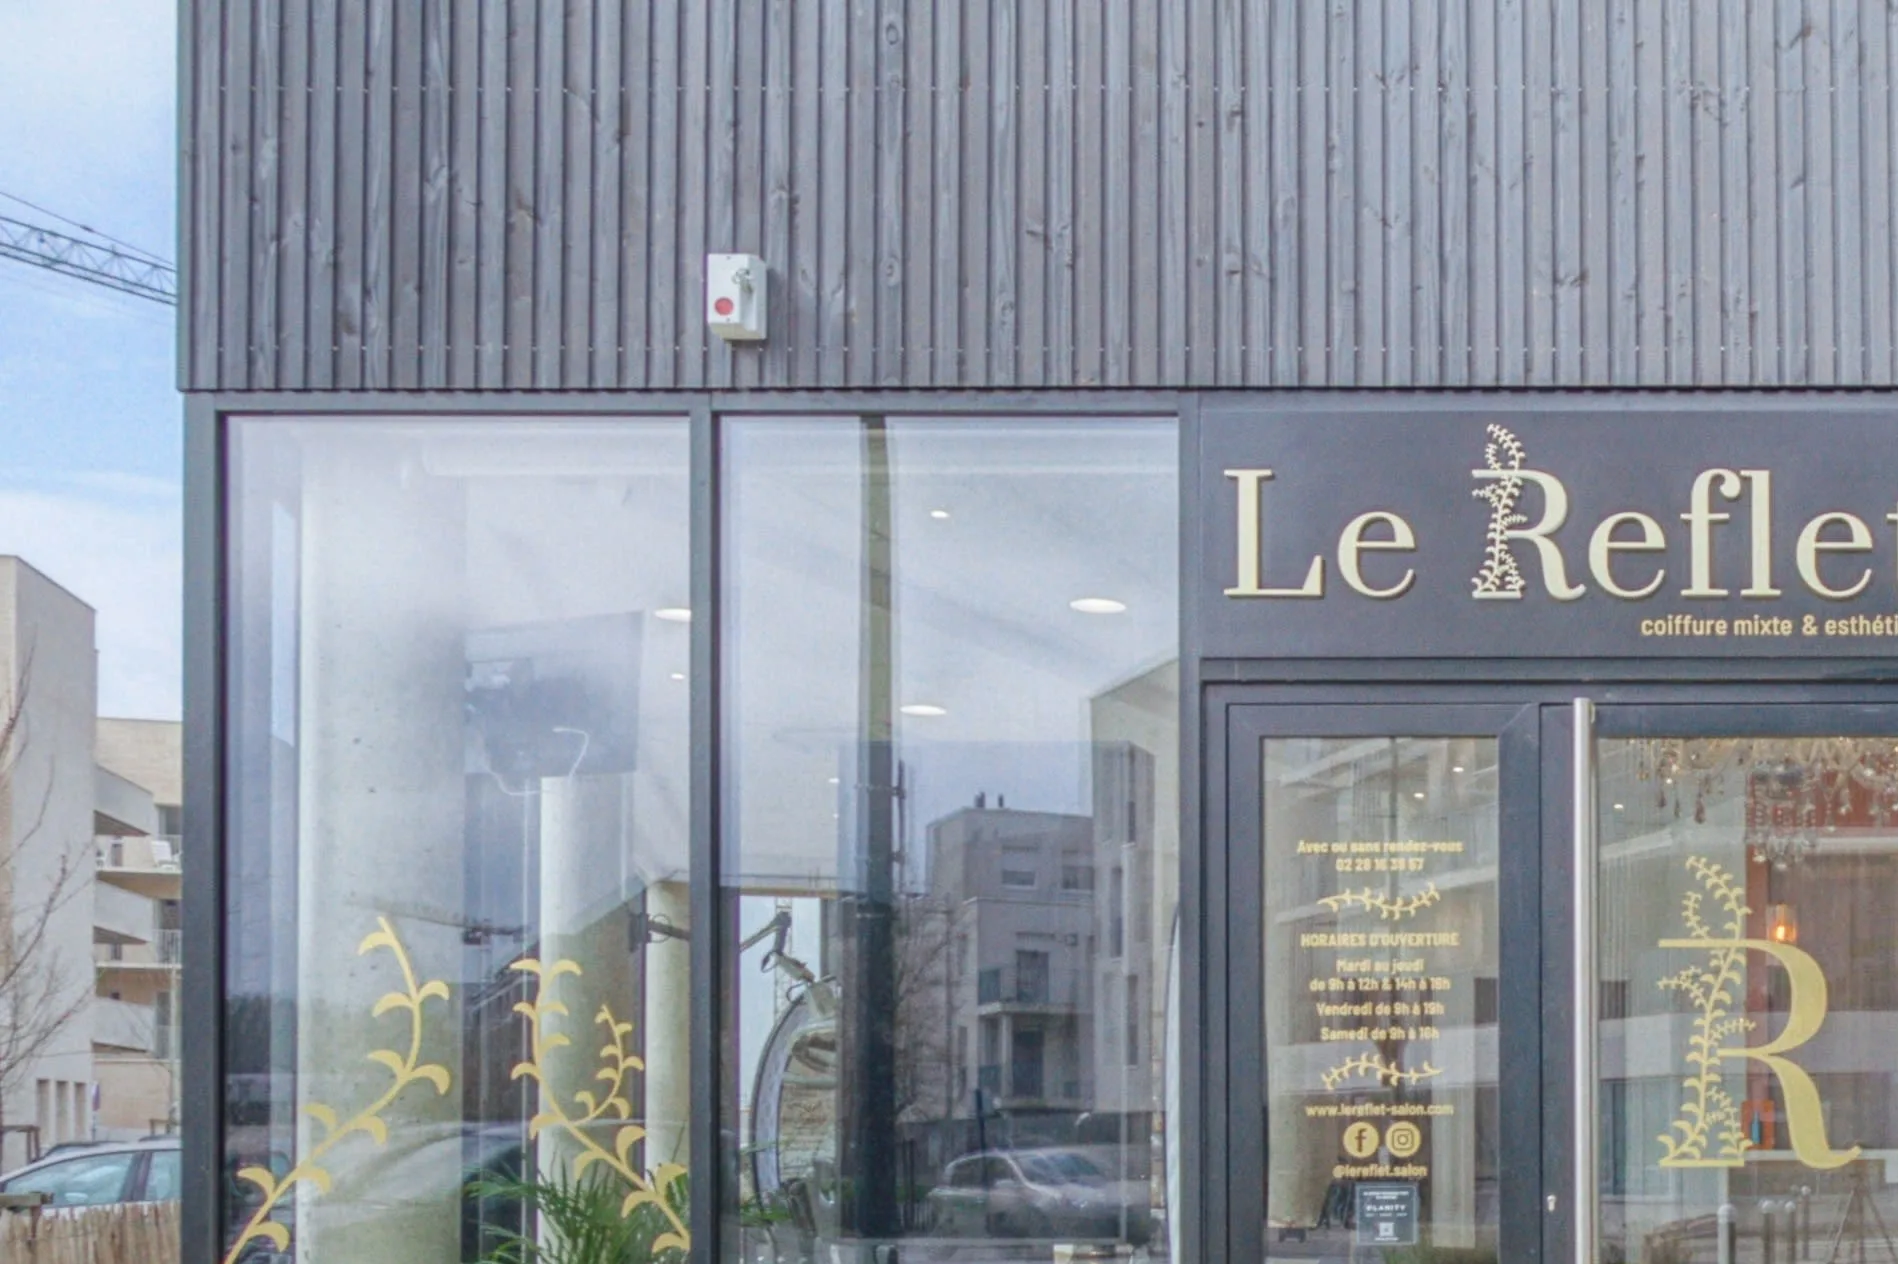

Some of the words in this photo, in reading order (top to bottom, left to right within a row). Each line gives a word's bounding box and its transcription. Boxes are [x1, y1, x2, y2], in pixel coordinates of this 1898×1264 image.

[1222, 468, 1418, 600] Le
[1640, 614, 1728, 637] coiffure
[1732, 614, 1794, 637] mixte
[1801, 614, 1819, 637] &
[1297, 839, 1329, 854] Avec
[1331, 842, 1349, 854] ou
[1351, 842, 1381, 854] sans
[1383, 839, 1465, 853] rendez-vous
[1336, 857, 1352, 872] 02
[1301, 932, 1367, 947] HORAIRES
[1368, 931, 1461, 947] D'OUVERTURE
[1335, 958, 1373, 973] Mardi
[1374, 961, 1390, 973] au
[1391, 958, 1425, 974] jeudi
[1309, 976, 1326, 991] de
[1358, 976, 1380, 991] 12h
[1381, 976, 1392, 991] &
[1394, 976, 1417, 991] 14h
[1316, 1002, 1373, 1016] Vendredi
[1375, 1002, 1392, 1016] de
[1320, 1027, 1369, 1041] Samedi
[1370, 1027, 1388, 1041] de
[1304, 1102, 1455, 1118] www.lereflet-salon.com
